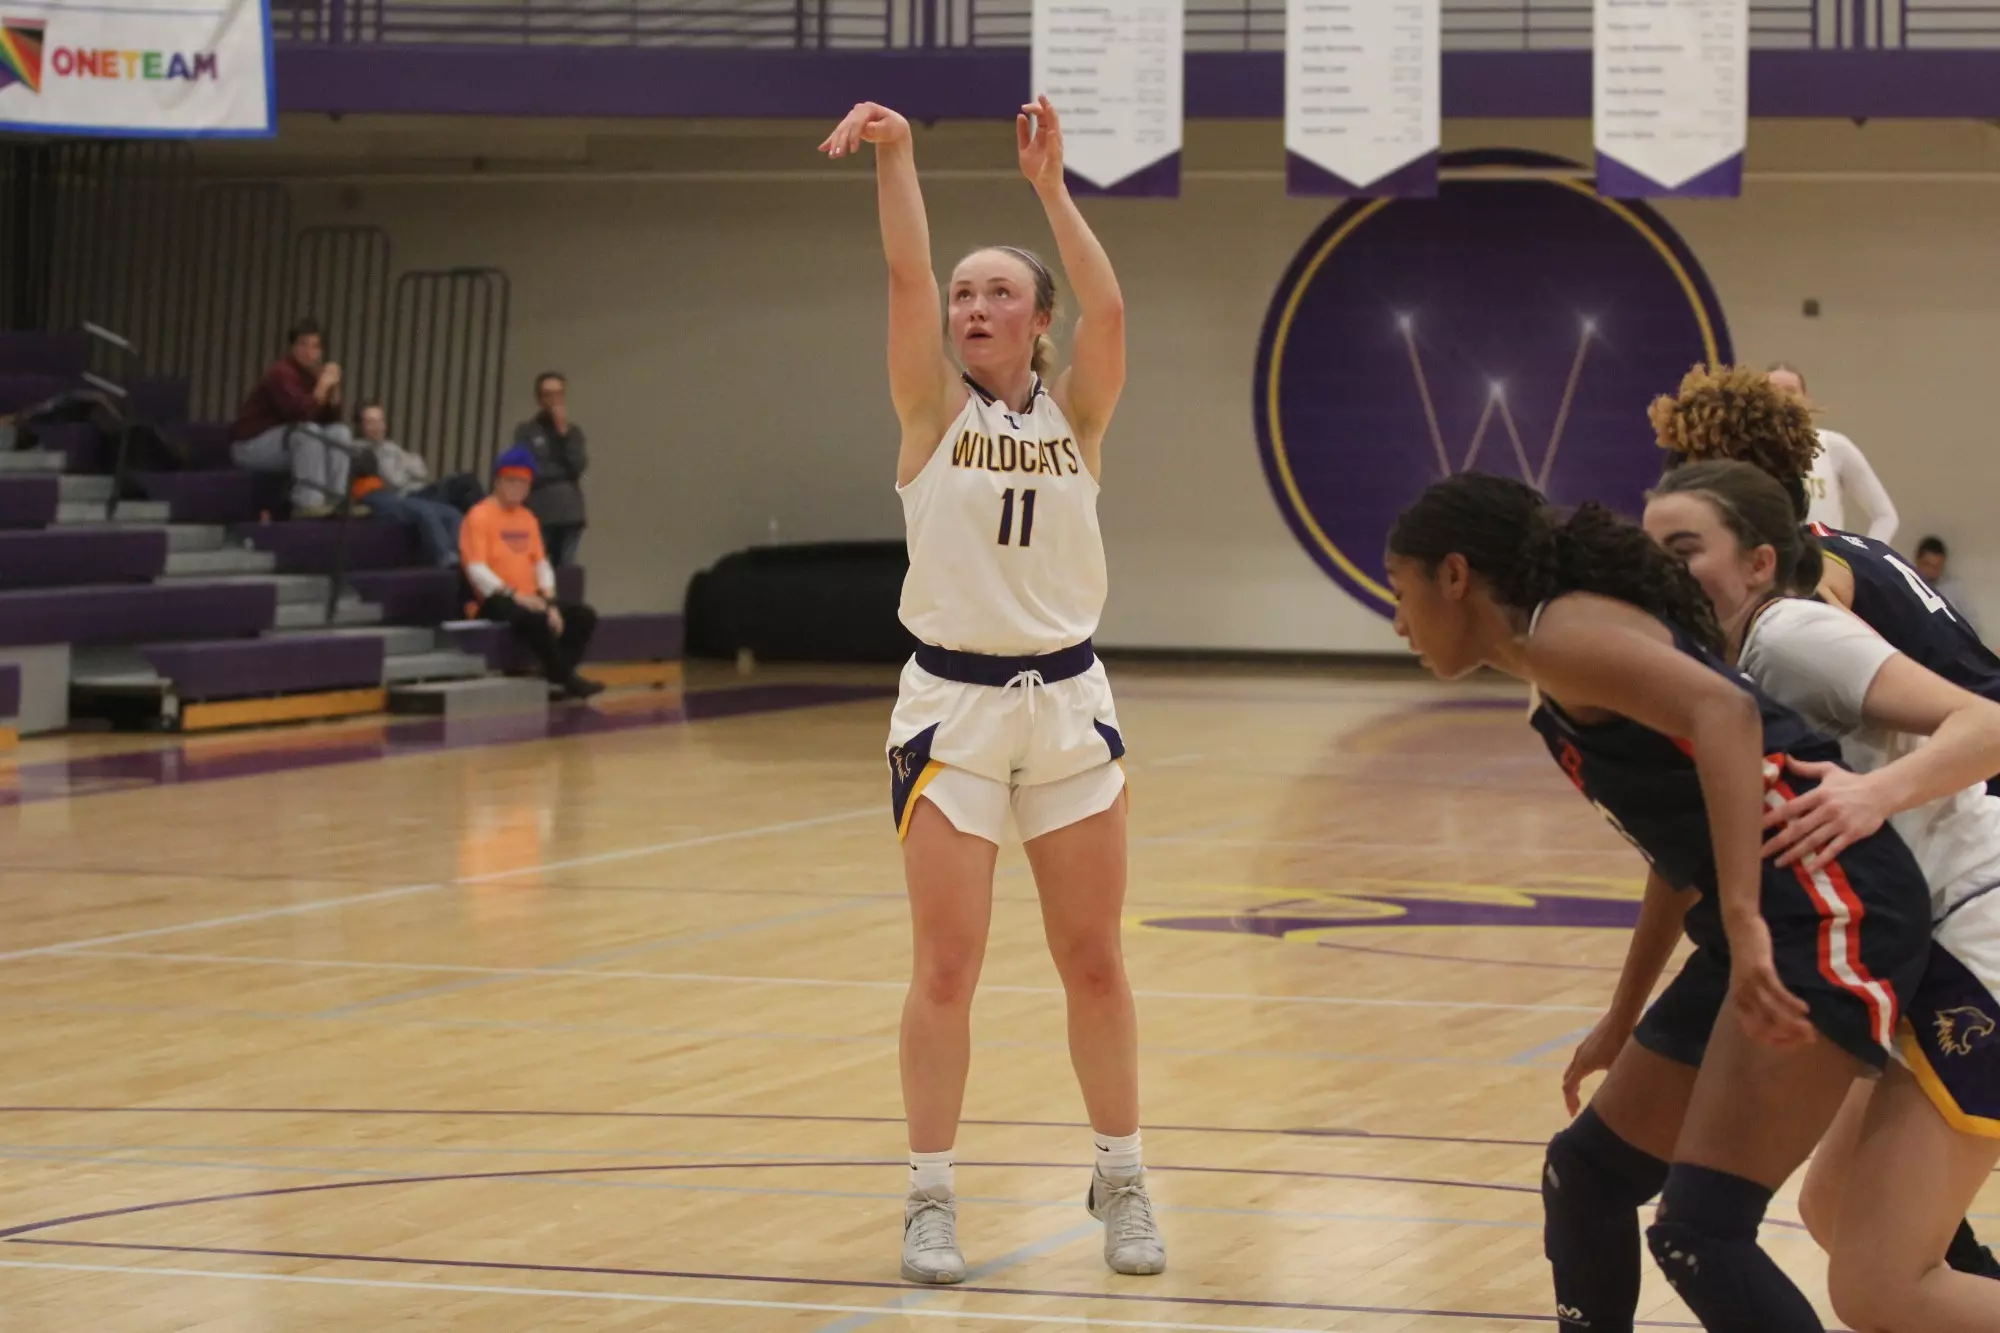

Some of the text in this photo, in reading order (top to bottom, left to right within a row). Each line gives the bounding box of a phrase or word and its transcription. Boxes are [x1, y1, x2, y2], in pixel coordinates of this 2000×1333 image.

[52, 46, 219, 80] ONETEAM
[951, 429, 1079, 477] WILDCATS
[997, 488, 1037, 548] 11
